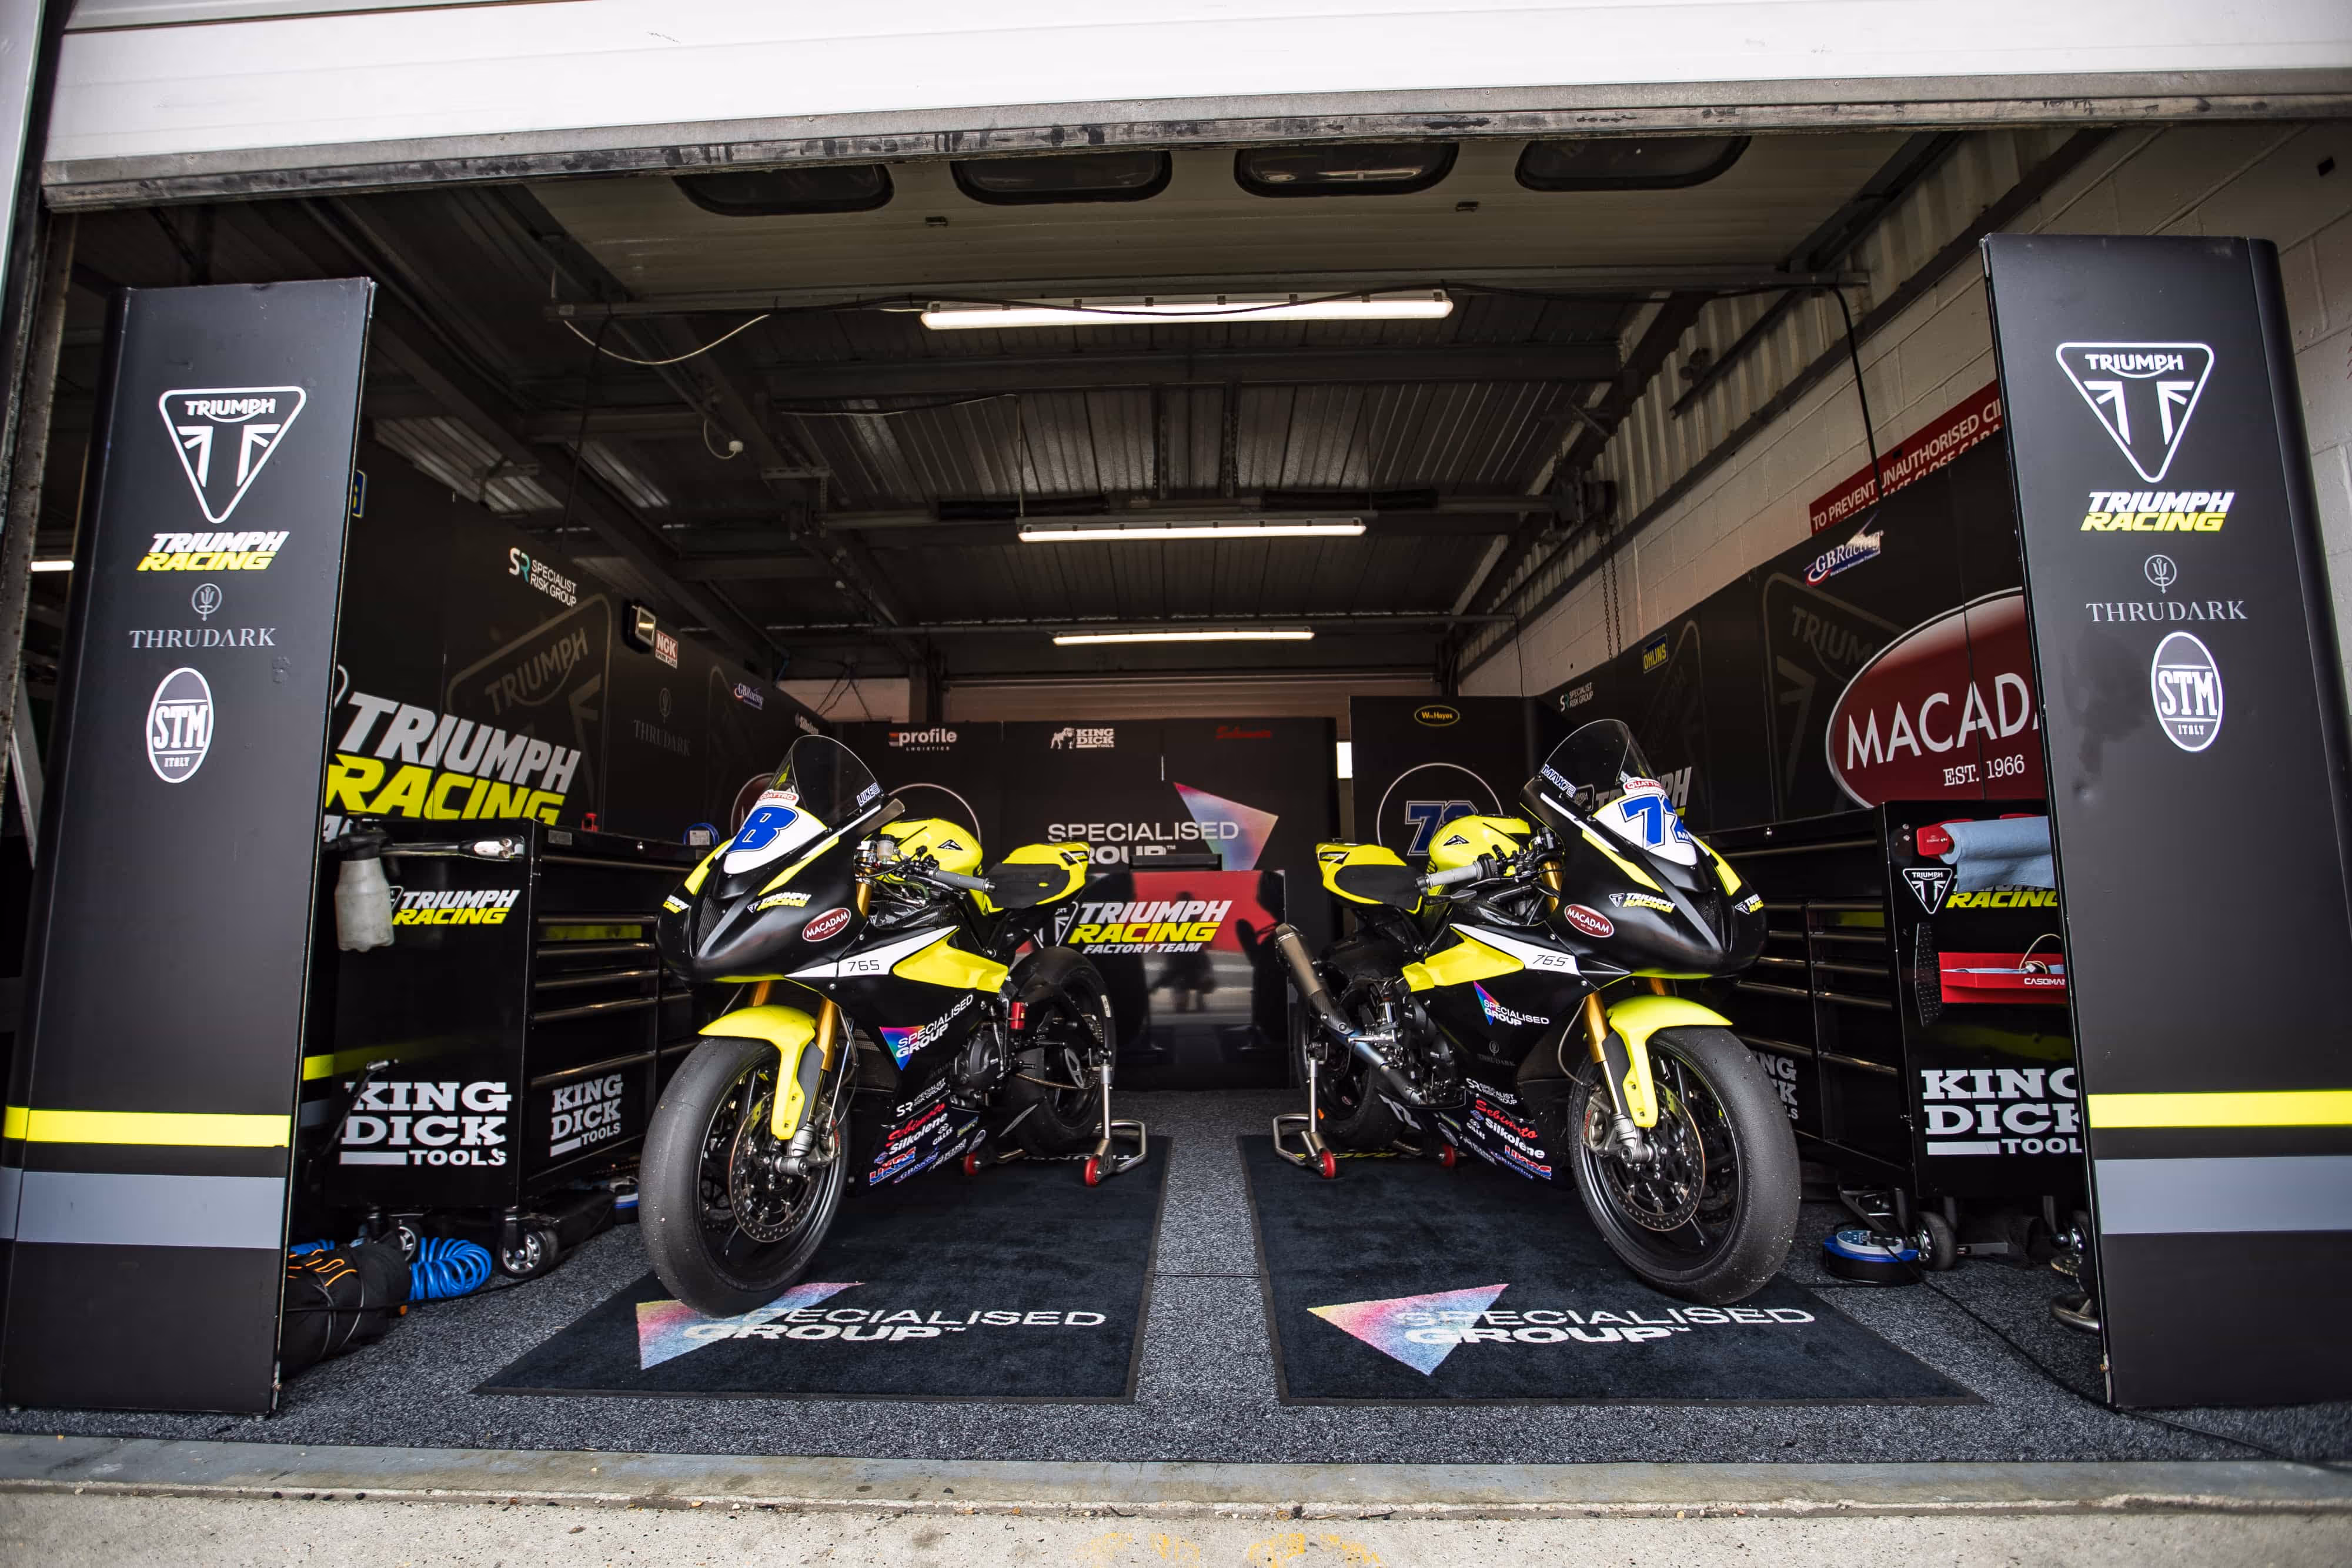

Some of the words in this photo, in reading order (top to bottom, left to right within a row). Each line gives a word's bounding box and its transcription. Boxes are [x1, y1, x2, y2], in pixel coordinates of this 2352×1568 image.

[2084, 354, 2184, 371] TRIUMPH
[184, 397, 276, 416] TRIUMPH
[1813, 511, 1826, 531] TO
[1829, 479, 1876, 521] PREVENT
[2089, 492, 2235, 512] TRIUMPH
[2080, 511, 2227, 531] RACING
[149, 531, 290, 553] TRIUMPH
[136, 551, 276, 571] RACING
[532, 559, 577, 594] SPECIALIST
[530, 573, 550, 594] RISK
[550, 584, 577, 607] GROUP
[2086, 600, 2249, 621] THRUDARK
[129, 628, 276, 648] THRUDARK
[657, 631, 677, 658] NGK
[484, 627, 588, 716] TRIUMPH
[2158, 671, 2217, 716] STM
[152, 705, 208, 749] STM
[1077, 728, 1114, 737] KING
[1847, 673, 2039, 770] MACAD
[338, 691, 582, 794] TRIUMPH
[898, 728, 957, 747] profile
[1943, 764, 1980, 787] EST.
[1987, 754, 2025, 779] 1966
[325, 753, 566, 827] RACING
[728, 805, 799, 854] 8
[1048, 822, 1239, 842] SPECIALISED
[402, 889, 521, 910] TRIUMPH
[1080, 901, 1232, 924] TRIUMPH
[392, 908, 511, 925] RACING
[806, 912, 848, 938] MACADAM
[1567, 908, 1609, 934] MACADAM
[1068, 922, 1220, 944] RACING
[1083, 944, 1155, 955] FACTORY
[1157, 942, 1202, 954] TEAM
[1533, 954, 1569, 967] 765
[847, 959, 880, 972] 765
[897, 994, 974, 1048] SPECIALISED
[1484, 999, 1550, 1025] SPECIALISED
[1484, 1007, 1522, 1026] GROUP
[896, 1022, 949, 1058] GROUP
[344, 1081, 513, 1111] KING
[552, 1073, 624, 1112] KING
[340, 1115, 508, 1146] DICK
[551, 1101, 622, 1141] DICK
[580, 1121, 622, 1147] TOOLS
[888, 1112, 948, 1155] Silkolene
[1485, 1117, 1546, 1159] Silkolene
[409, 1148, 508, 1166] TOOLS
[742, 1307, 1107, 1326] PECIALISED
[1395, 1306, 1816, 1326] SPECIALISED
